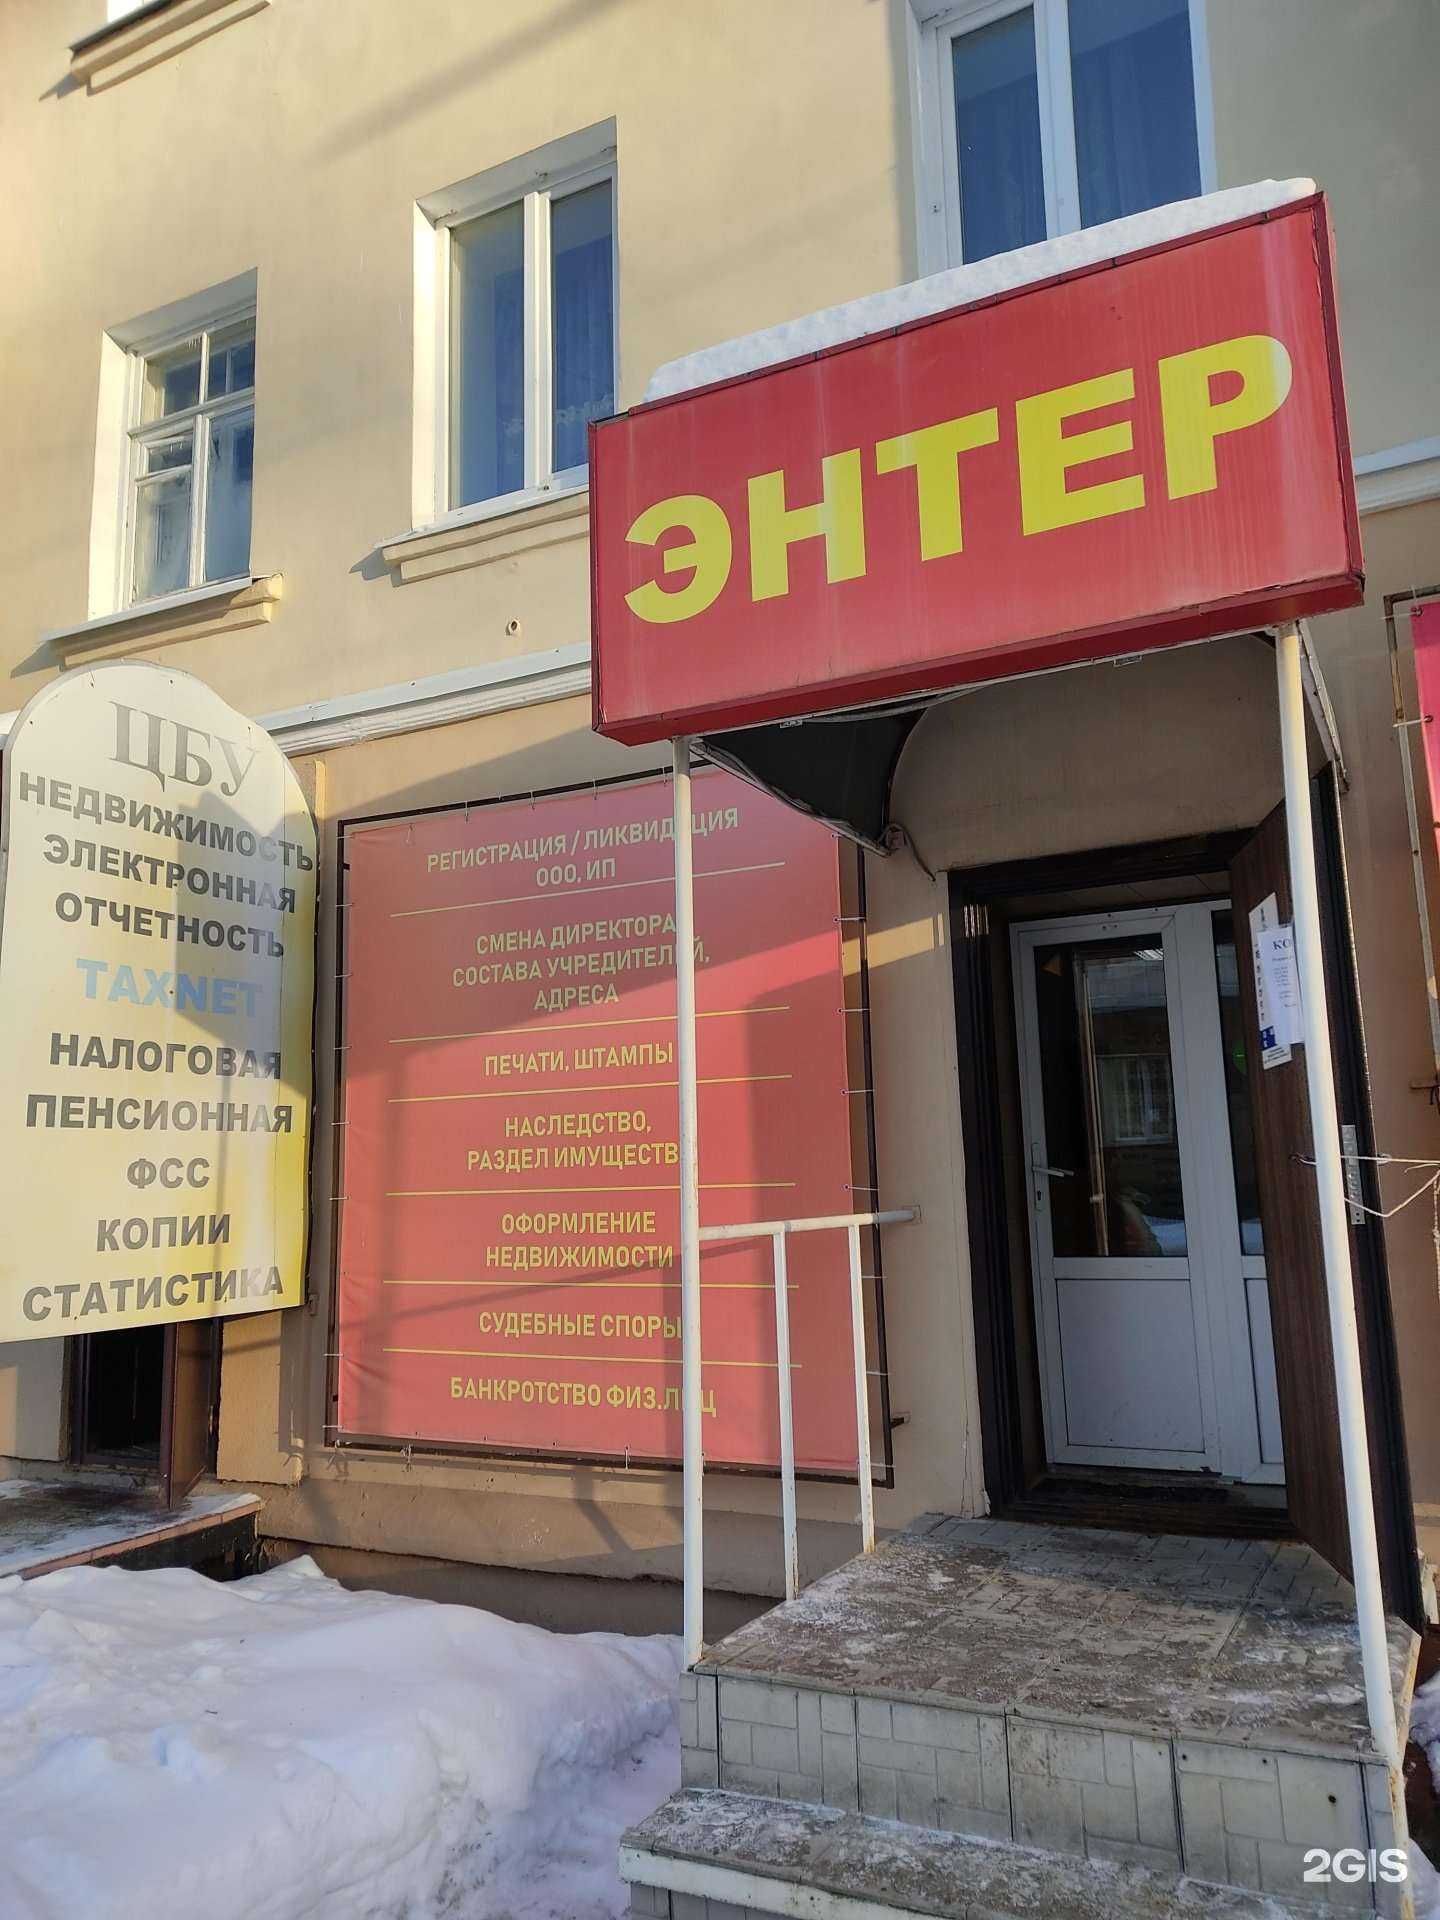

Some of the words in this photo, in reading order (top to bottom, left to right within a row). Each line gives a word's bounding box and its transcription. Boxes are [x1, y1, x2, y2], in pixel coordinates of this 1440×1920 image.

[624, 334, 1293, 624] ЭНТЕР
[108, 701, 259, 796] ЦБУ
[19, 771, 313, 872] НЕДВИЖИМОСТЬ
[427, 835, 567, 873] РЕГИСТРАЦИЯ
[584, 807, 739, 850] ЛИКВИДЦИЯ
[43, 833, 296, 914] ЭЛЕКТРОННАЯ
[586, 857, 616, 882] ИП
[55, 892, 284, 959] ОТЧЕТНОСТЬ
[476, 929, 546, 955] СМЕНА
[550, 912, 677, 951] ДИРЕКТОРА
[453, 963, 542, 988] СОСТАВА
[547, 936, 710, 979] УЧРЕДИТЕЛЙ,
[76, 957, 262, 1018] TAXNET
[534, 983, 619, 1011] АДРЕСА
[50, 1032, 281, 1080] НАЛОГОВАЯ
[484, 1050, 570, 1077] ПЕЧАТИ,
[574, 1042, 674, 1070] ШТАМПЫ
[26, 1093, 293, 1133] ПЕНСИОННАЯ
[505, 1110, 652, 1138] НАСЛЕДСТВО,
[127, 1157, 210, 1189] ФСС
[467, 1147, 549, 1173] РАЗДЕЛ
[553, 1142, 679, 1170] ИМУЩЕСТВ
[96, 1214, 231, 1252] КОПИИ
[502, 1211, 656, 1234] ОФОРМЛЕНИЕ
[486, 1245, 673, 1271] НЕДВИЖИМОСТИ
[22, 1266, 283, 1322] СТАТИСТИКА
[479, 1311, 596, 1338] СУДЕБНЫЕ
[600, 1314, 682, 1339] СПОРЫ
[450, 1376, 601, 1407] БАНКРОТСТВО
[606, 1384, 717, 1418] ФИЗ.ЛЦ
